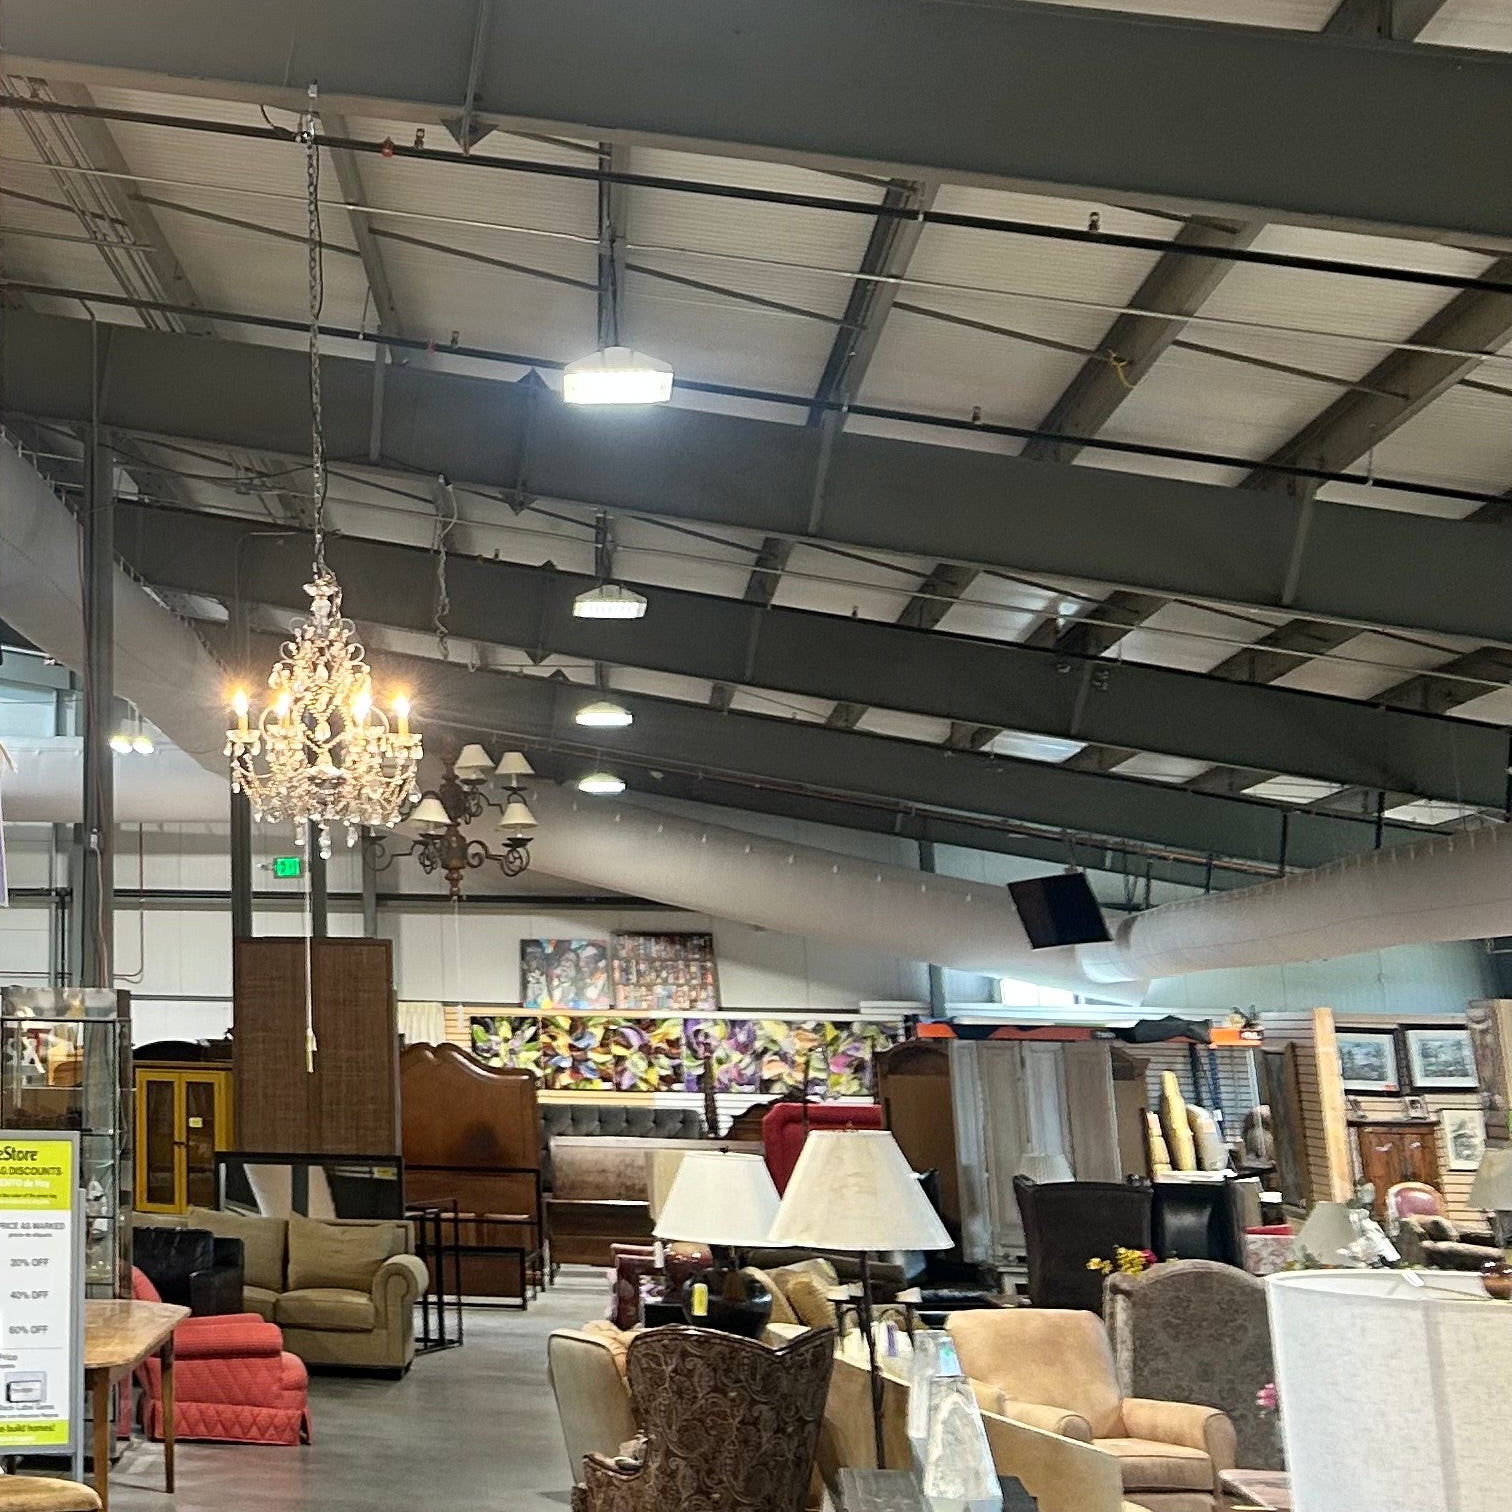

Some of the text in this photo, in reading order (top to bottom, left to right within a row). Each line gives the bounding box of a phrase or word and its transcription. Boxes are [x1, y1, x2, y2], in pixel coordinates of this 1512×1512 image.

[9, 1166, 62, 1176] DISCOUNTS
[31, 1257, 49, 1267] OFF
[31, 1290, 49, 1300] OFF
[30, 1325, 49, 1334] OFF
